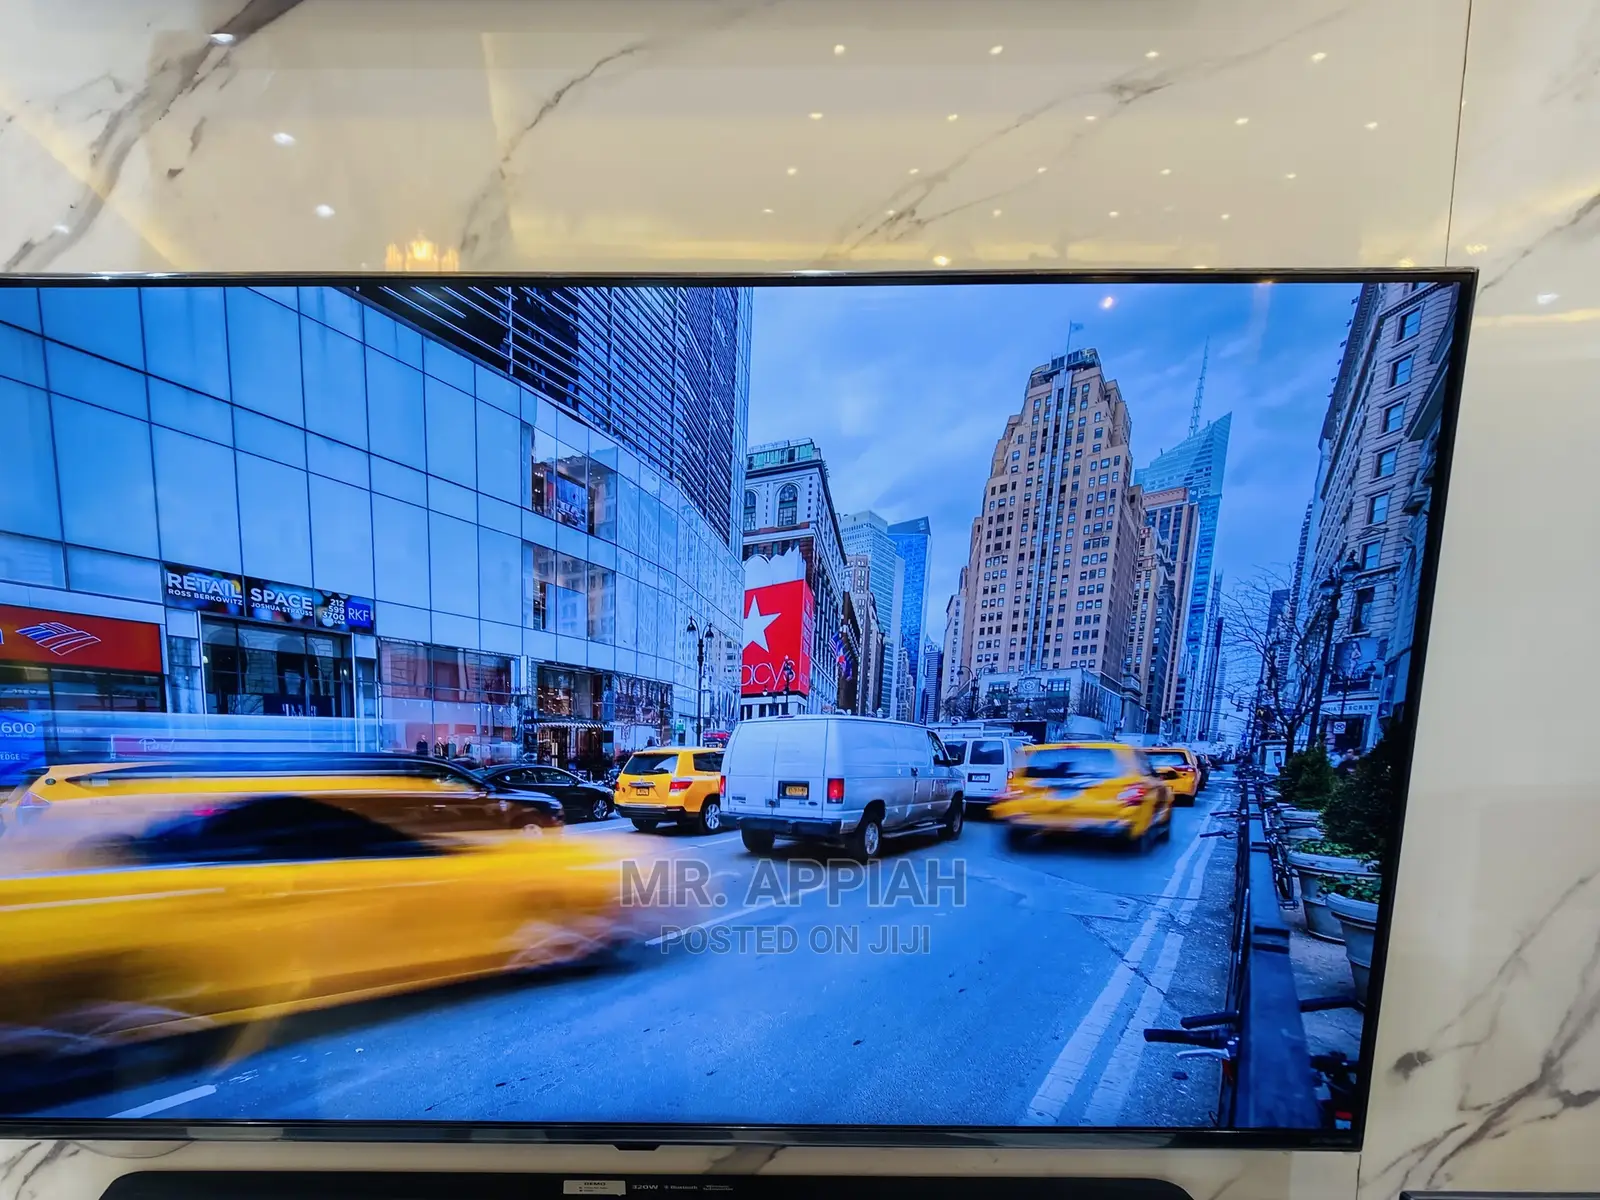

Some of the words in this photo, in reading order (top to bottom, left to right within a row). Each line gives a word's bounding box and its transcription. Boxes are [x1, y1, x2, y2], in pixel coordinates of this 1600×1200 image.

[167, 572, 242, 598] RETAIL
[250, 588, 313, 610] SPACE
[168, 588, 192, 597] ROSS
[193, 592, 243, 606] BERKOWITZ
[251, 602, 281, 611] JOSHUA
[282, 606, 313, 617] STRAUSS
[328, 605, 345, 614] 599
[330, 598, 345, 607] 212
[322, 611, 345, 621] 3700
[348, 607, 369, 621] RKF
